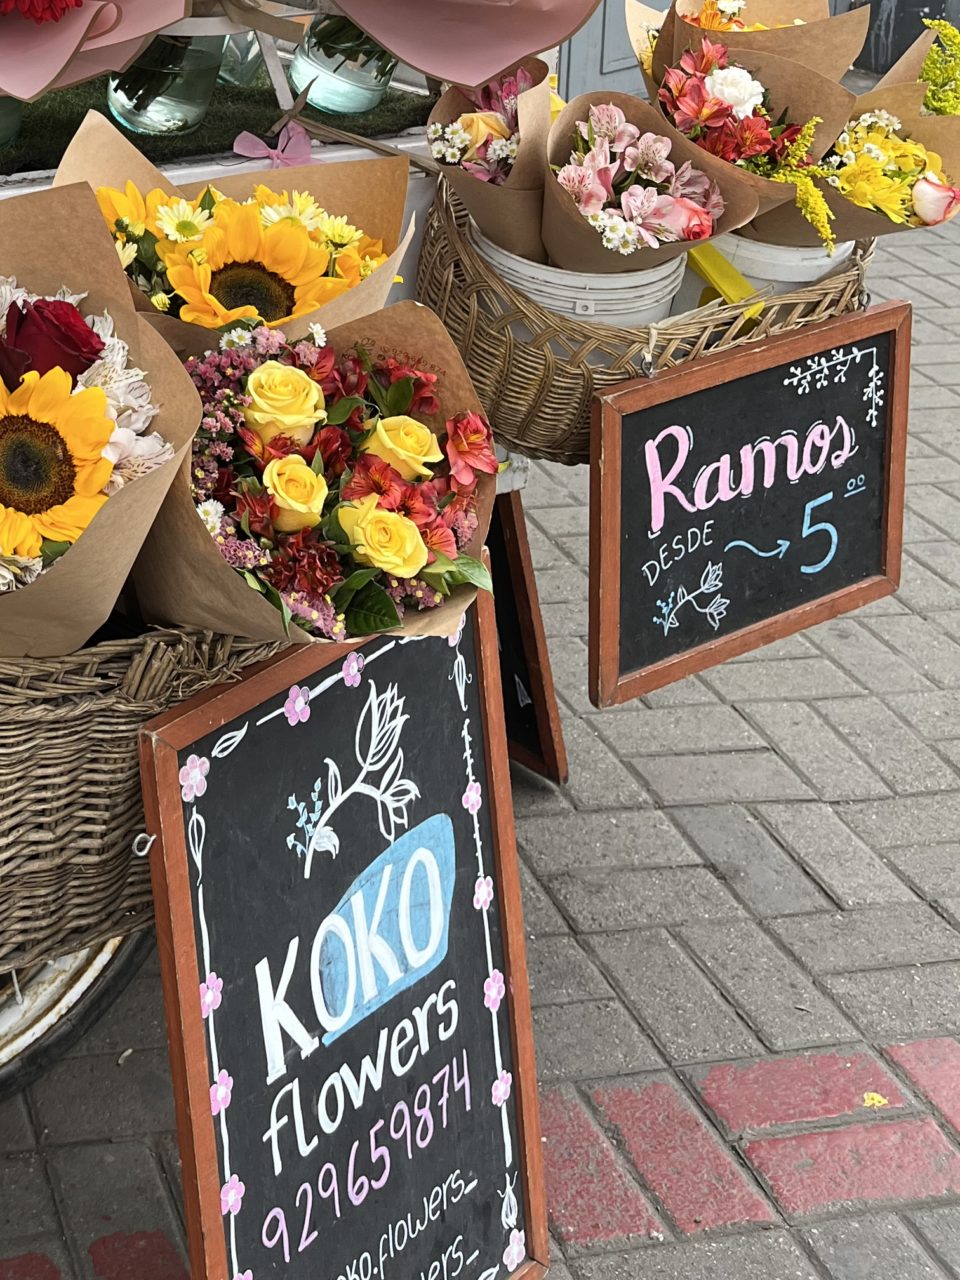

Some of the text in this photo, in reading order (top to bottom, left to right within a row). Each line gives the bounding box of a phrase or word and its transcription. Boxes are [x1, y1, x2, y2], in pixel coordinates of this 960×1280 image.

[641, 520, 715, 587] DESDE
[644, 416, 859, 532] Ramos
[254, 846, 445, 1086] KOKO
[260, 1047, 472, 1263] 929659874
[261, 978, 459, 1177] flowers
